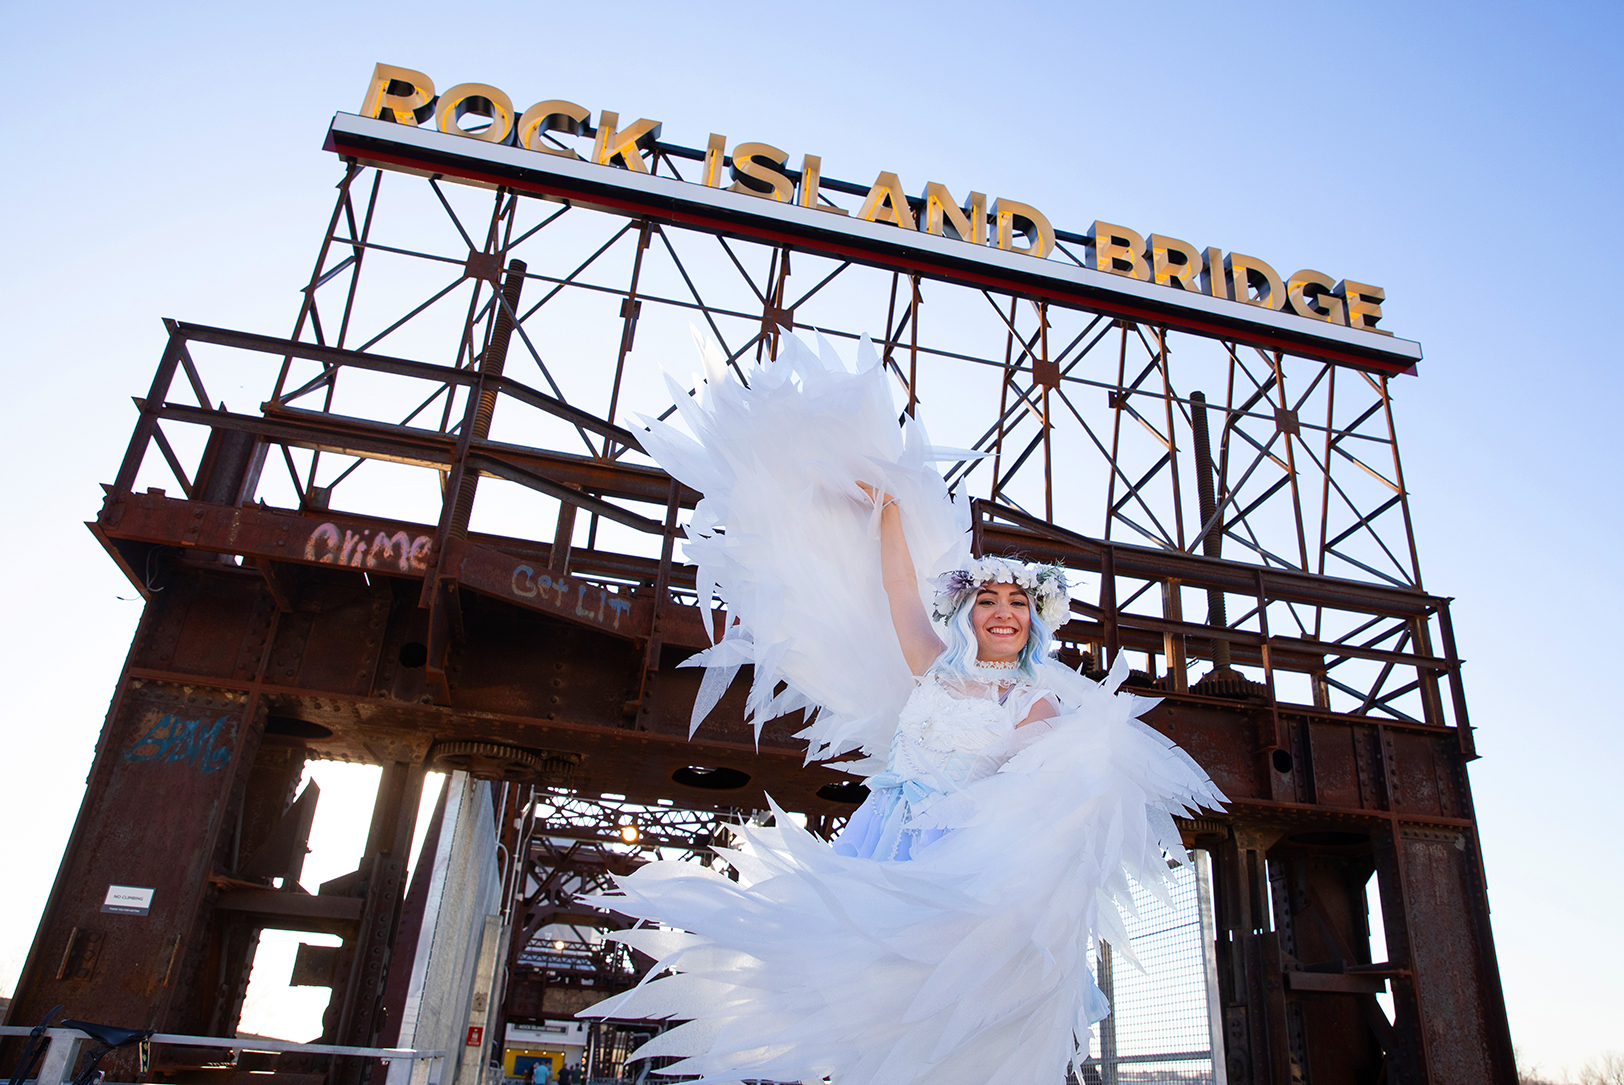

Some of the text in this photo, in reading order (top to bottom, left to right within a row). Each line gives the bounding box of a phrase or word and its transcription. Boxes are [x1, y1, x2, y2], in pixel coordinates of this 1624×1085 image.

[359, 62, 1394, 337] ROCK ISLAND BRIDGE
